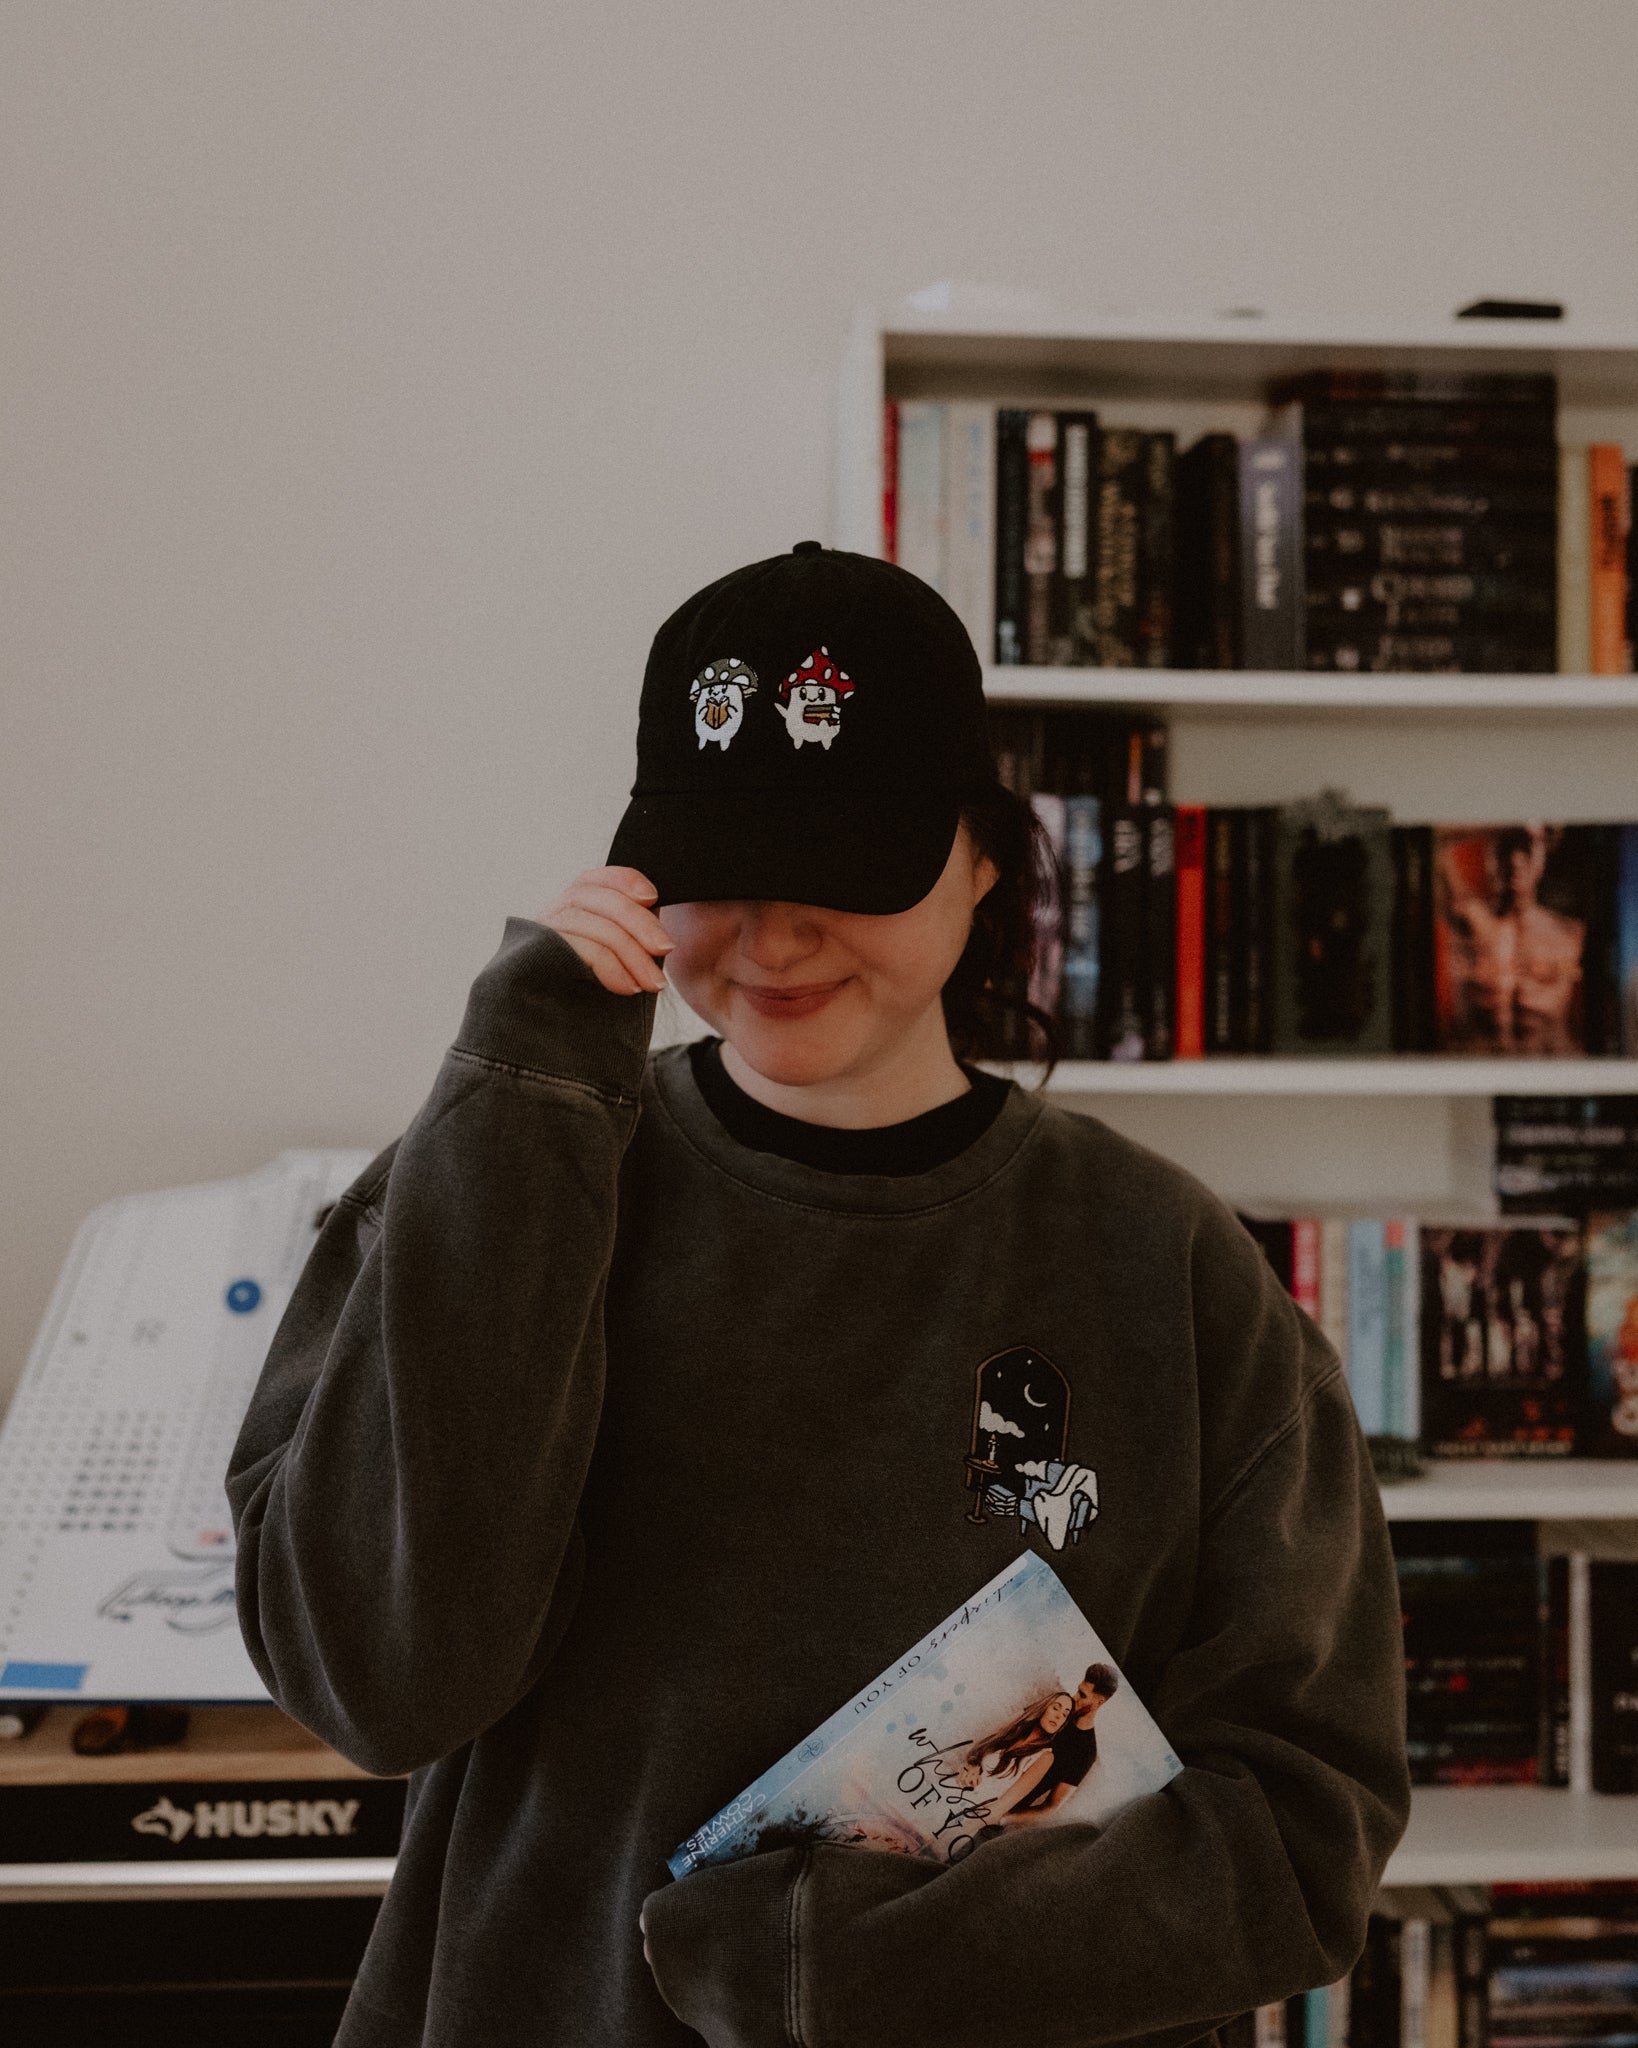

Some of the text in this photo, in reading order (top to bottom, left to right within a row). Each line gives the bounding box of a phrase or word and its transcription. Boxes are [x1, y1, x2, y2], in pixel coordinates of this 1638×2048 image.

[854, 1577, 1014, 1714] hispers OF YOU
[194, 1799, 361, 1838] HUSKY
[686, 1793, 751, 1850] COWLES
[897, 1766, 975, 1864] OF YO
[907, 1727, 1000, 1838] whisp
[682, 1794, 766, 1869] CATHERINE
